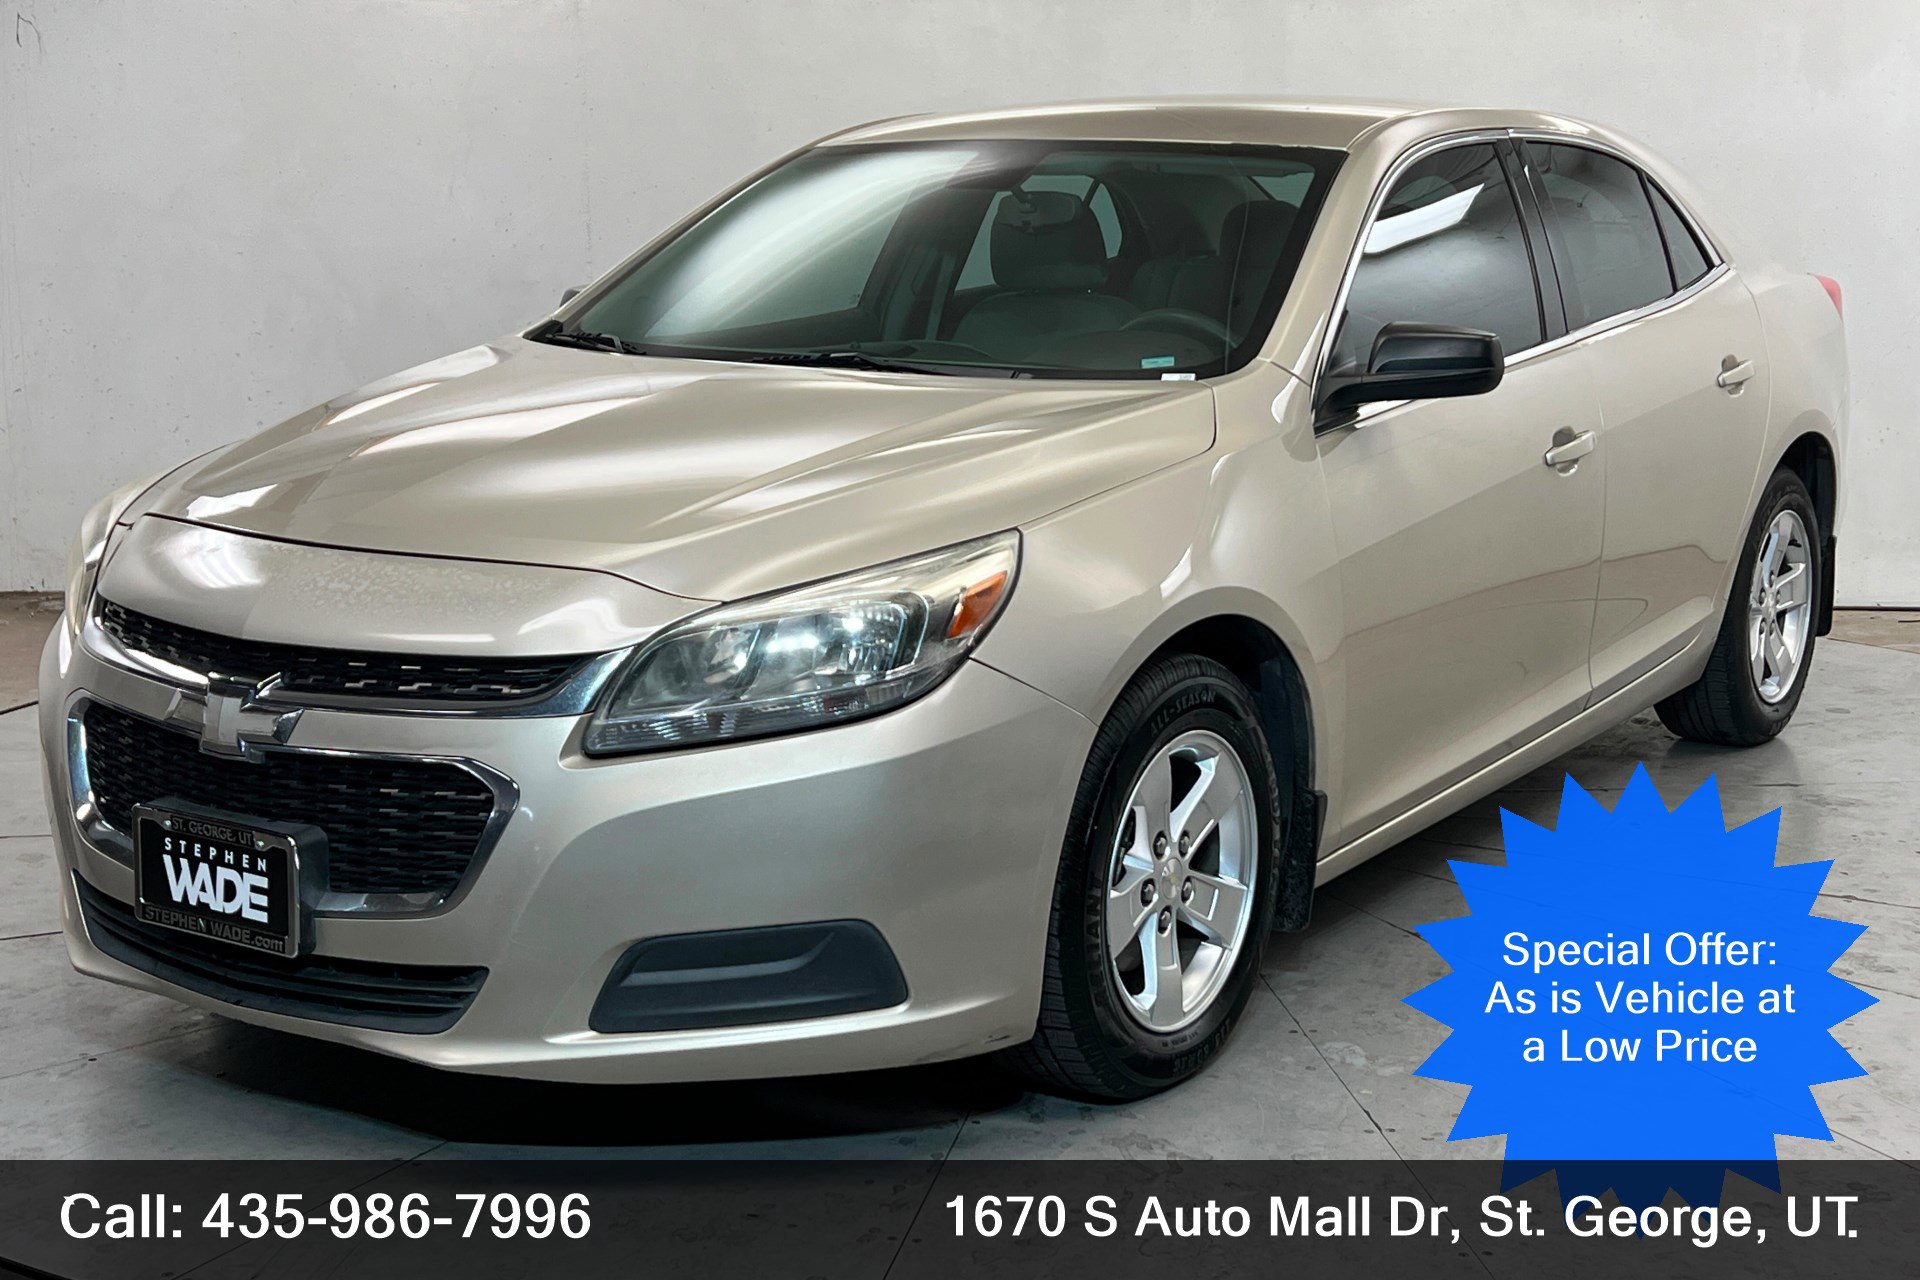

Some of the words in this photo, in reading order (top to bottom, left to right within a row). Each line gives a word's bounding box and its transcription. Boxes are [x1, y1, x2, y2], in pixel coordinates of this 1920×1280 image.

[164, 837, 267, 872] STEPHEN
[238, 832, 252, 846] UT
[162, 853, 269, 924] WADE
[146, 907, 207, 932] STEPHEN
[211, 922, 283, 952] WADE.com
